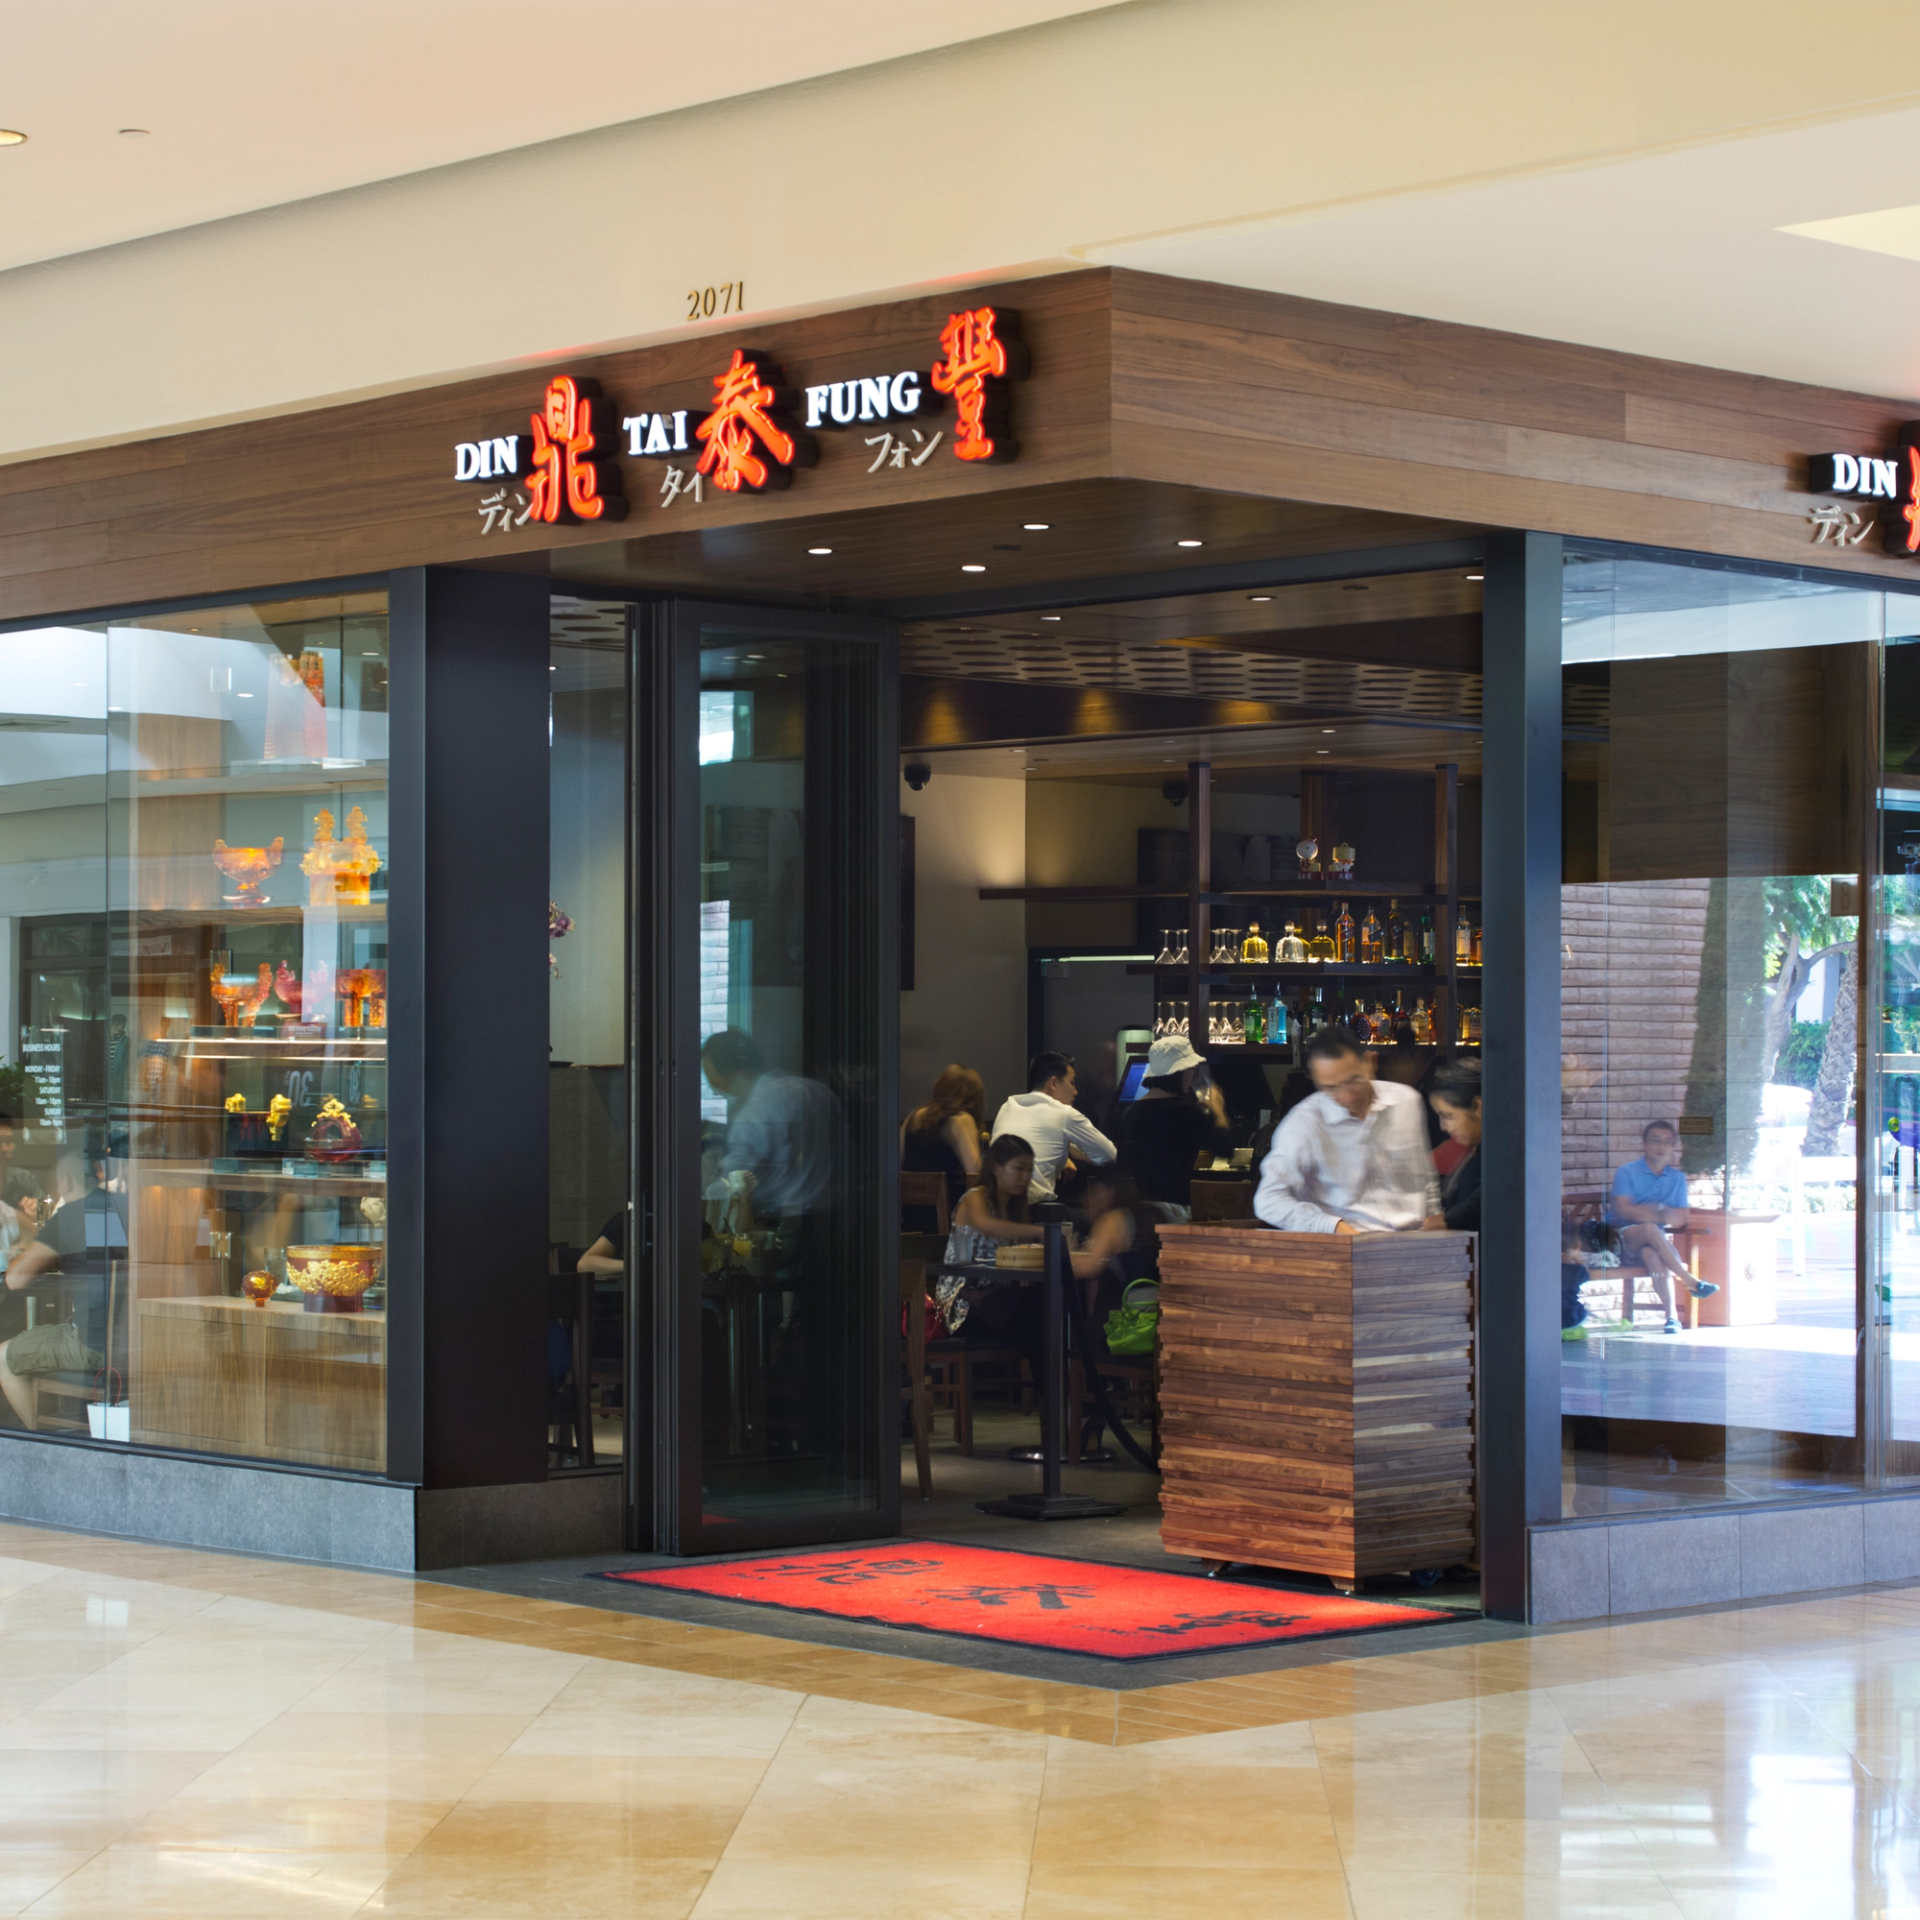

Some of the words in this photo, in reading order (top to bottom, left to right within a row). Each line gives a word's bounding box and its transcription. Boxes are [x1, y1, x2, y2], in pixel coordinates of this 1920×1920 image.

[687, 281, 743, 320] 2071
[454, 435, 519, 480] DIN
[525, 375, 604, 522] 鼎
[622, 410, 688, 455] TAI
[696, 349, 794, 492] 泰
[805, 371, 921, 427] FUNG
[478, 488, 533, 534] ディン
[660, 465, 703, 508] タイ
[865, 429, 943, 473] フォン
[1832, 453, 1898, 499] DIN
[1811, 505, 1874, 547] ディン
[23, 1043, 43, 1052] BUSINESS
[44, 1043, 61, 1052] HOURS
